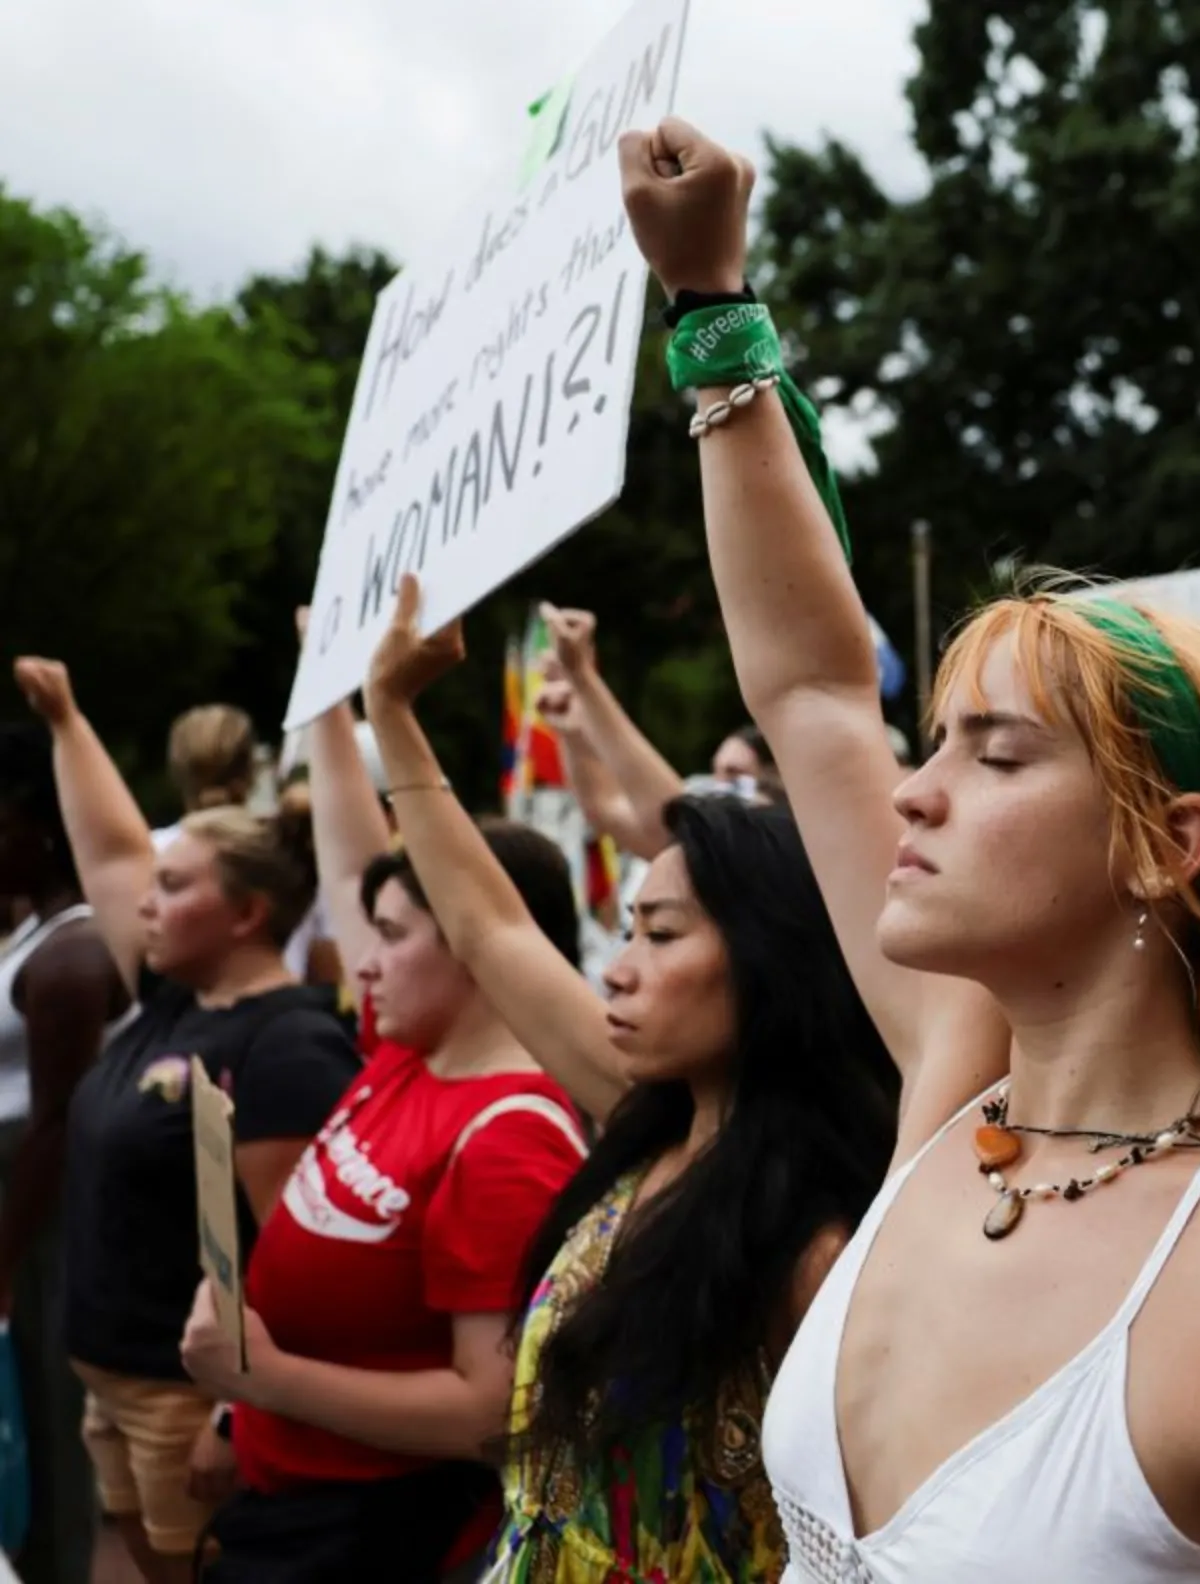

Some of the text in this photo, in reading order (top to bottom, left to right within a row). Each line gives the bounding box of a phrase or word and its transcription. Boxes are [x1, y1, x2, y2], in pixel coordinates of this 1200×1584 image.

[363, 267, 455, 422] How
[463, 197, 531, 294] does
[565, 22, 672, 181] GUN
[470, 280, 550, 393] rights
